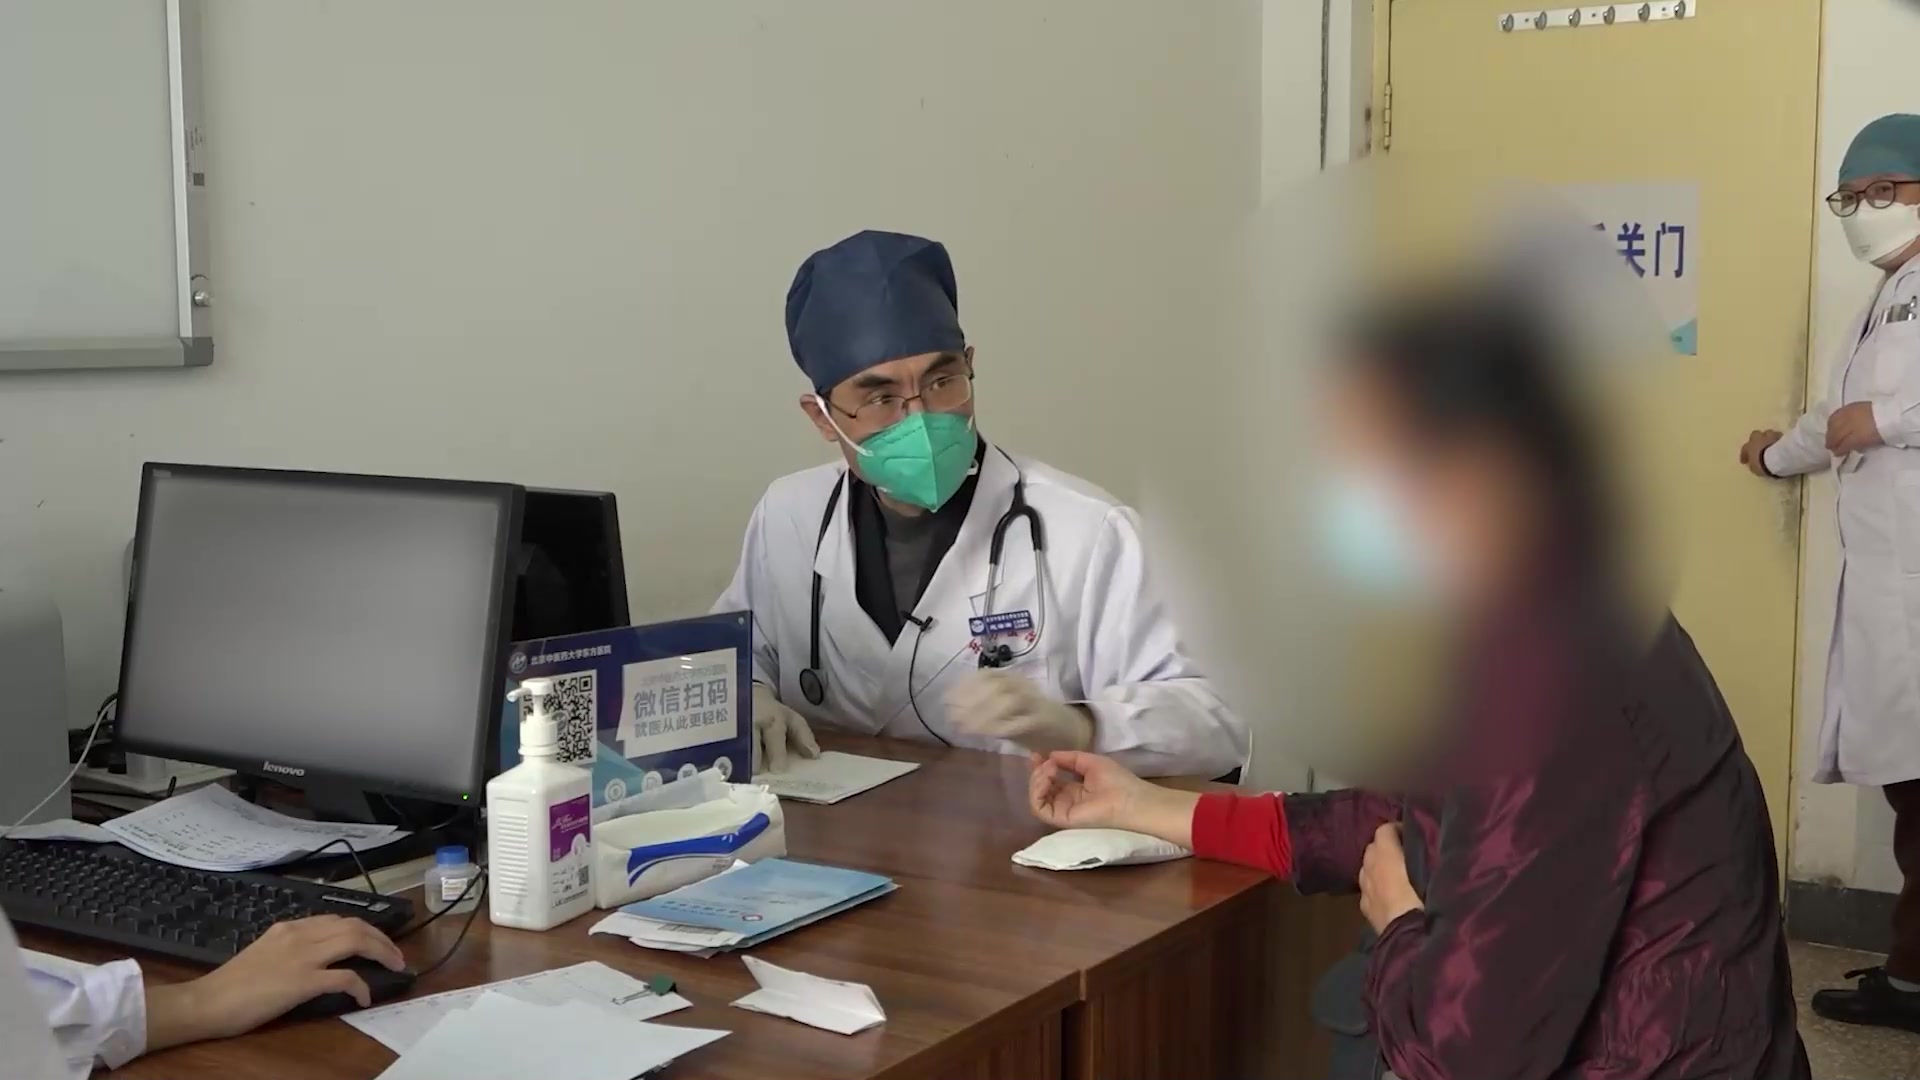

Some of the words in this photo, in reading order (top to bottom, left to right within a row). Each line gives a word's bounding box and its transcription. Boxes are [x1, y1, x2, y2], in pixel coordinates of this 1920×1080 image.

[1592, 221, 1685, 278] 关门
[633, 678, 728, 720] 微信扫码
[634, 708, 728, 738] 就医从此更轻松
[263, 760, 305, 777] lenovo
